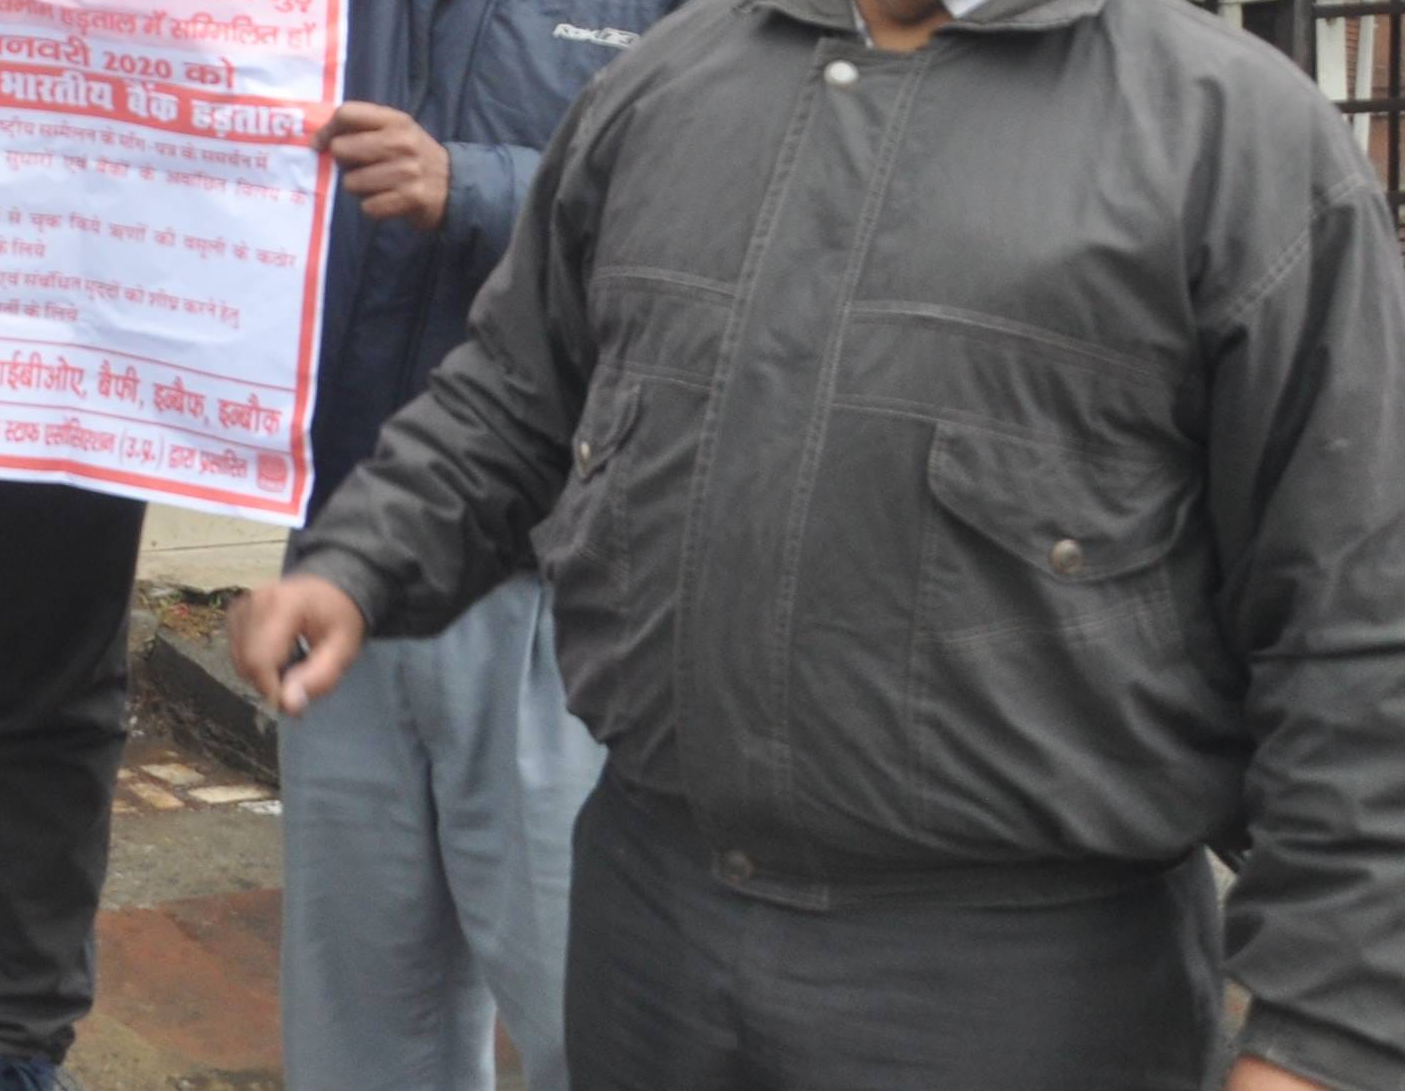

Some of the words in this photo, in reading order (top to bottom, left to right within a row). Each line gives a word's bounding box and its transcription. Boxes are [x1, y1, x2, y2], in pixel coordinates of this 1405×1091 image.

[143, 10, 167, 37] में
[102, 50, 173, 80] 2020
[182, 56, 236, 89] को
[0, 67, 113, 109] भारतीय
[123, 81, 180, 122] बैंक
[190, 99, 305, 139] हड़ताल
